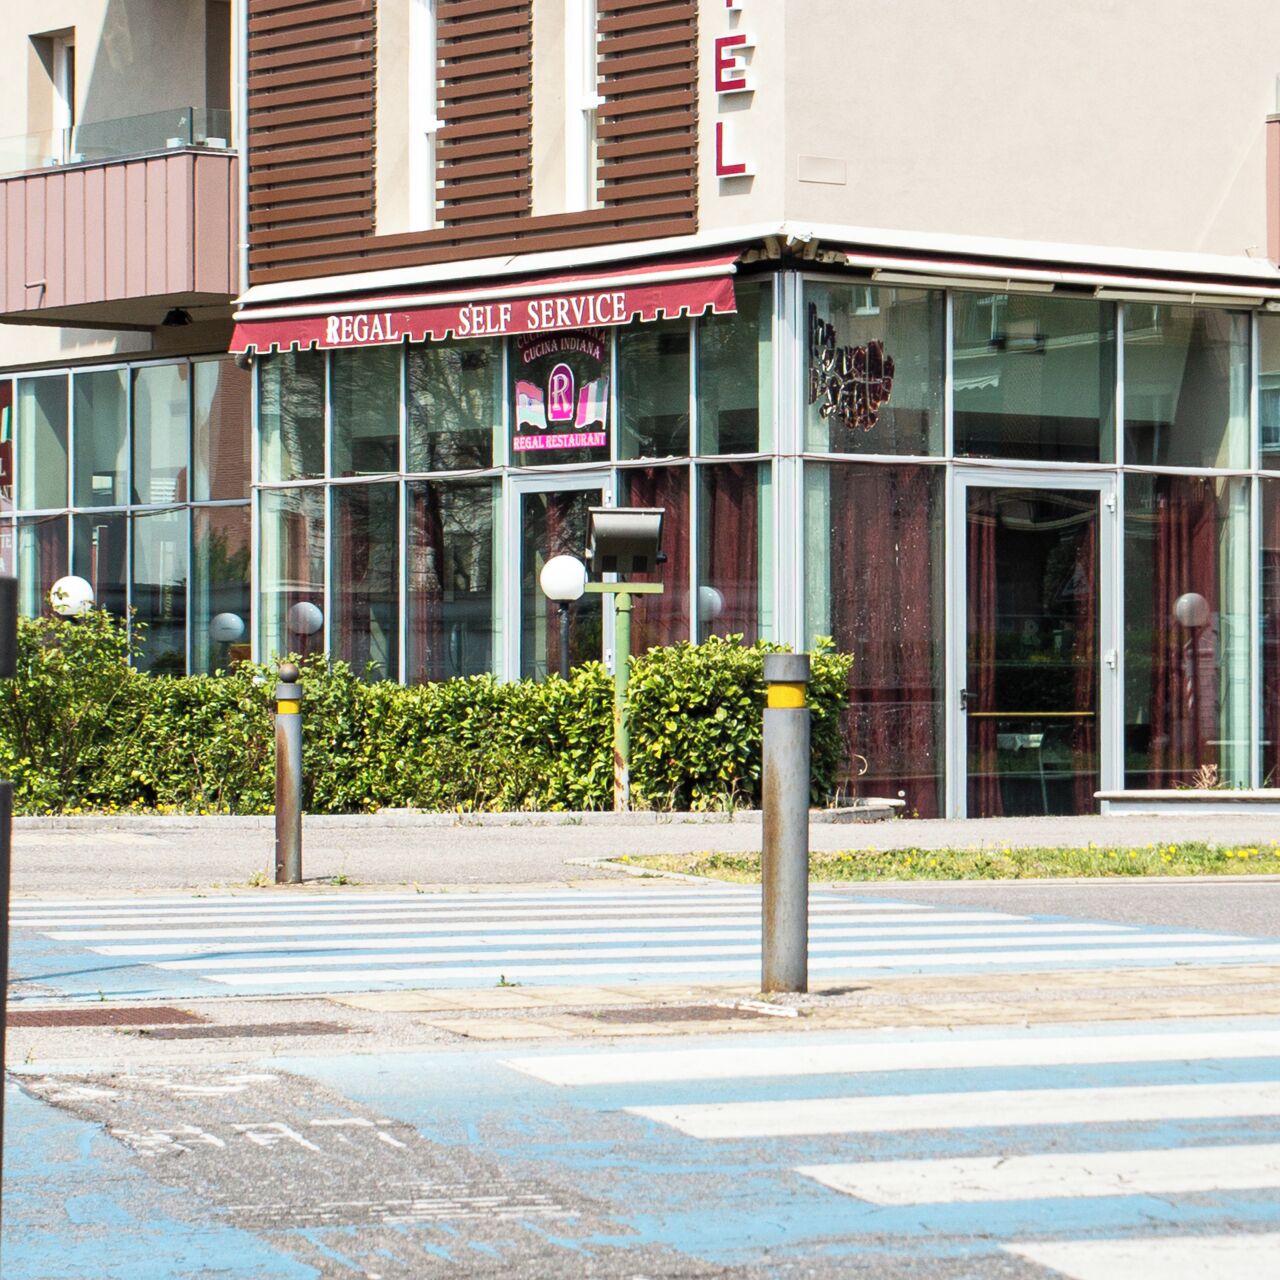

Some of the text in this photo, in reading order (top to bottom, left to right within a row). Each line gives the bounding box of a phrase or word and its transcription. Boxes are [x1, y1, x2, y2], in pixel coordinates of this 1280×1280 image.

[326, 292, 627, 344] REGAL SELF SERVICE
[523, 337, 600, 363] CUCINA INDIANA
[513, 432, 606, 450] REGAL RESTAURANT
